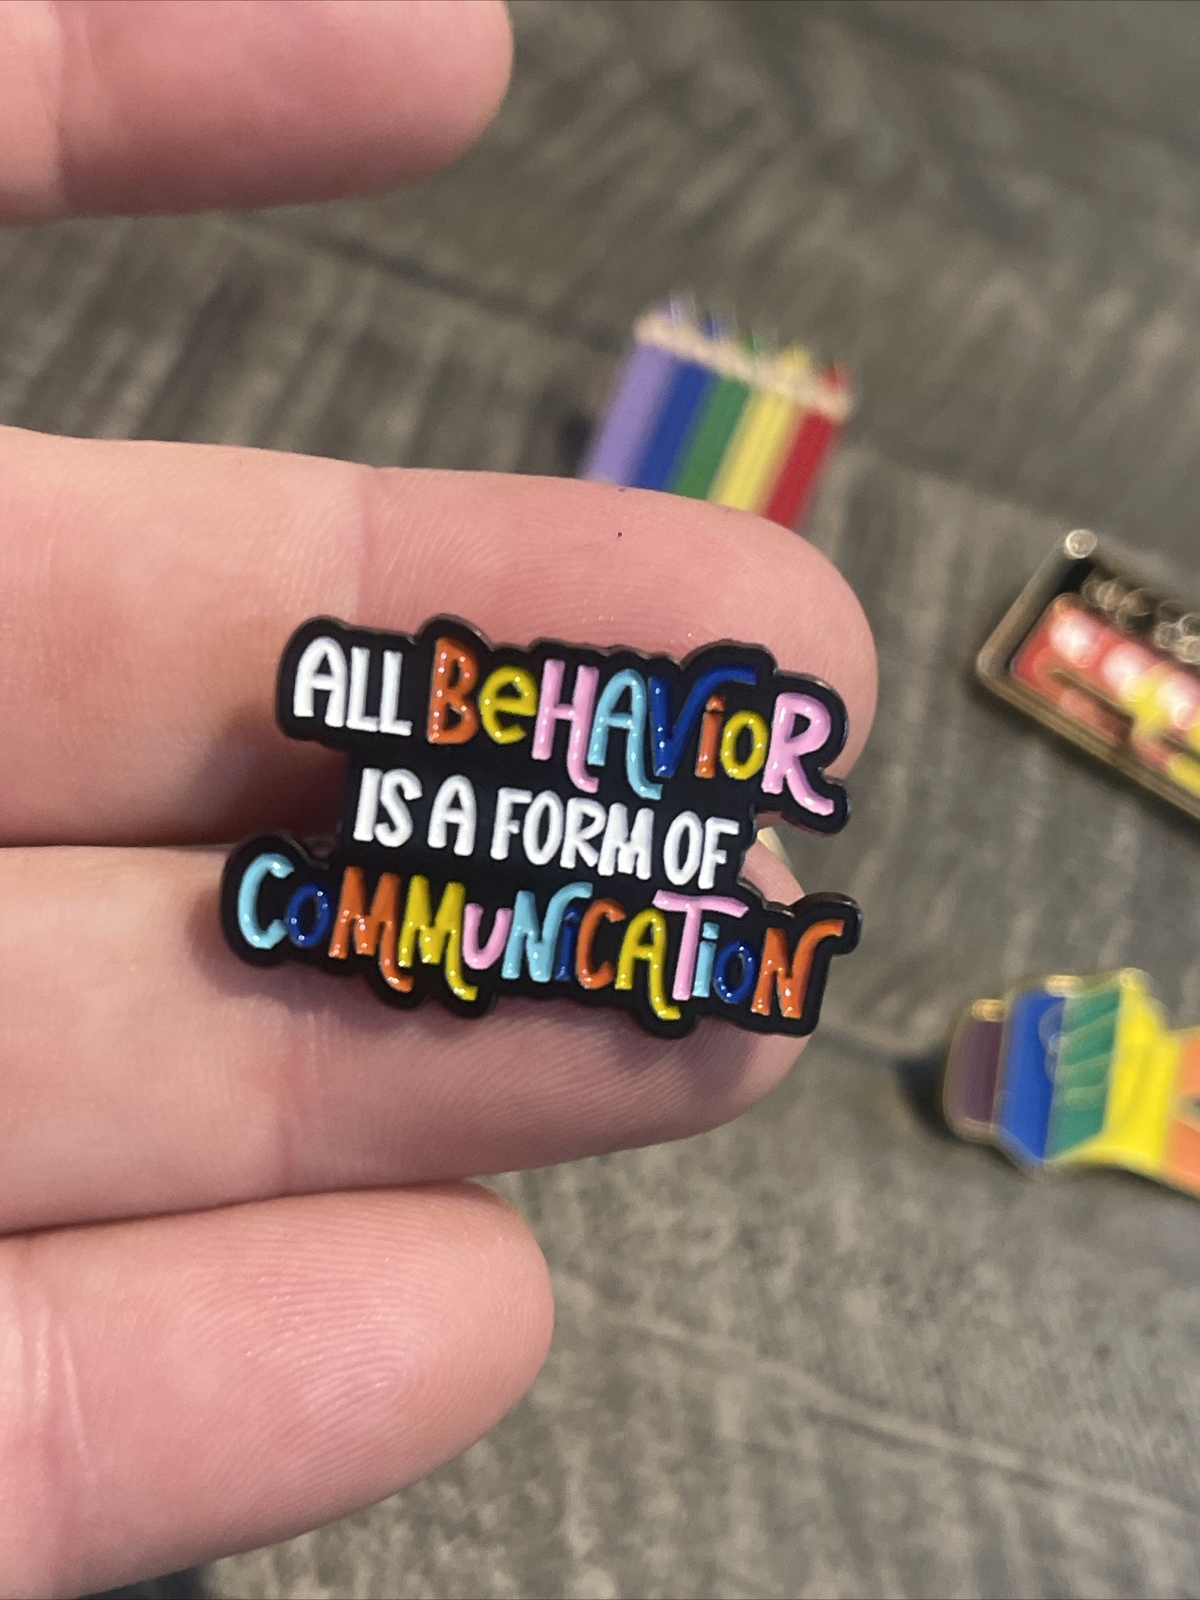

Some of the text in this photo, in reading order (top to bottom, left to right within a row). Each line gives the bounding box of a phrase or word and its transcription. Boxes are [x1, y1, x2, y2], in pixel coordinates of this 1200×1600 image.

[293, 636, 412, 736] ALL
[352, 767, 740, 889] IS A FORM OF
